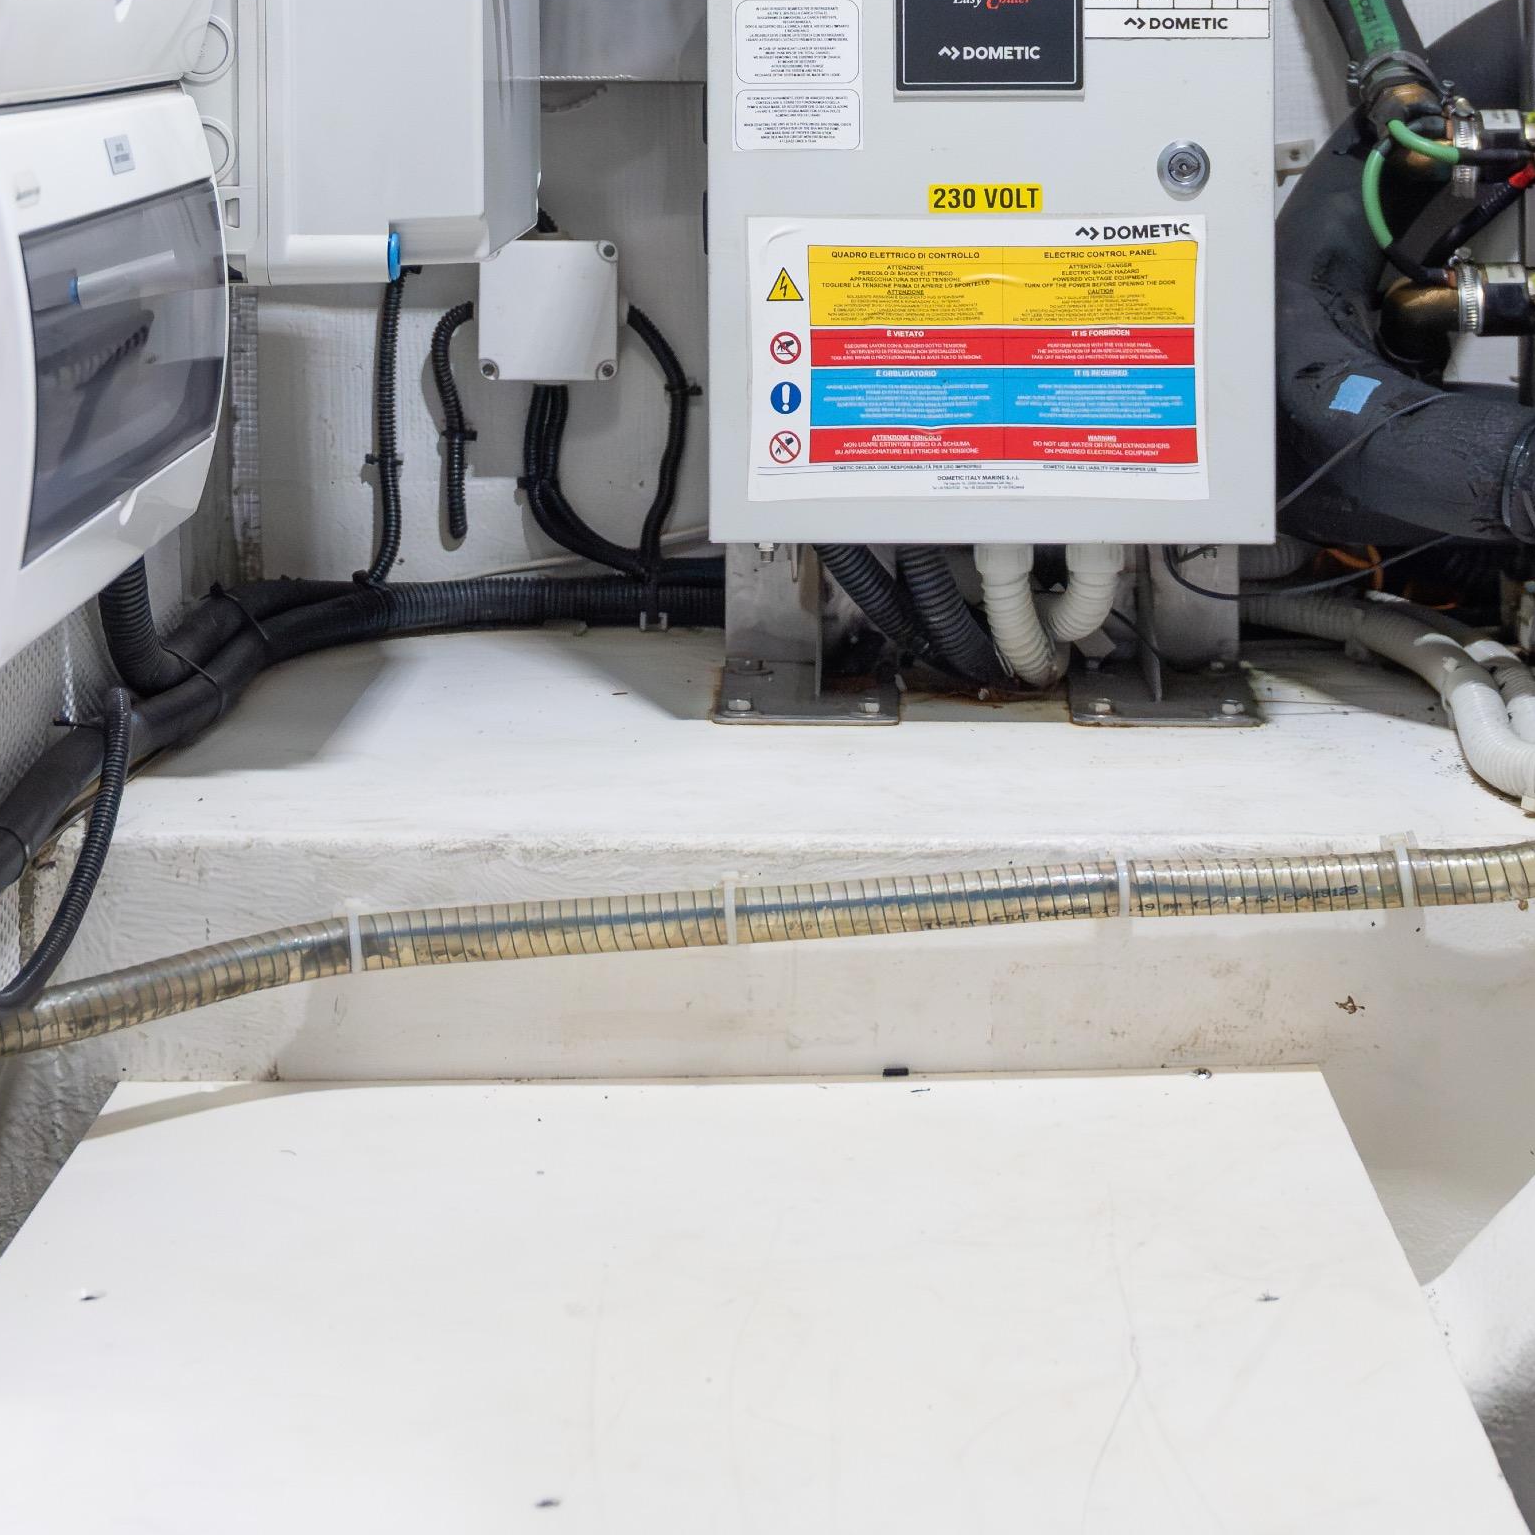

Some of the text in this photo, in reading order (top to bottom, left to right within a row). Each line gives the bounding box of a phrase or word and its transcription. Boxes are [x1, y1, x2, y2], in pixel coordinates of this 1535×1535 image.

[1149, 17, 1228, 29] DOMETIC
[963, 46, 1041, 60] DOMETIC
[933, 188, 1039, 209] 230 VOLT
[1103, 223, 1191, 240] DOMETIC
[1089, 329, 1131, 337] FORBIDDEN
